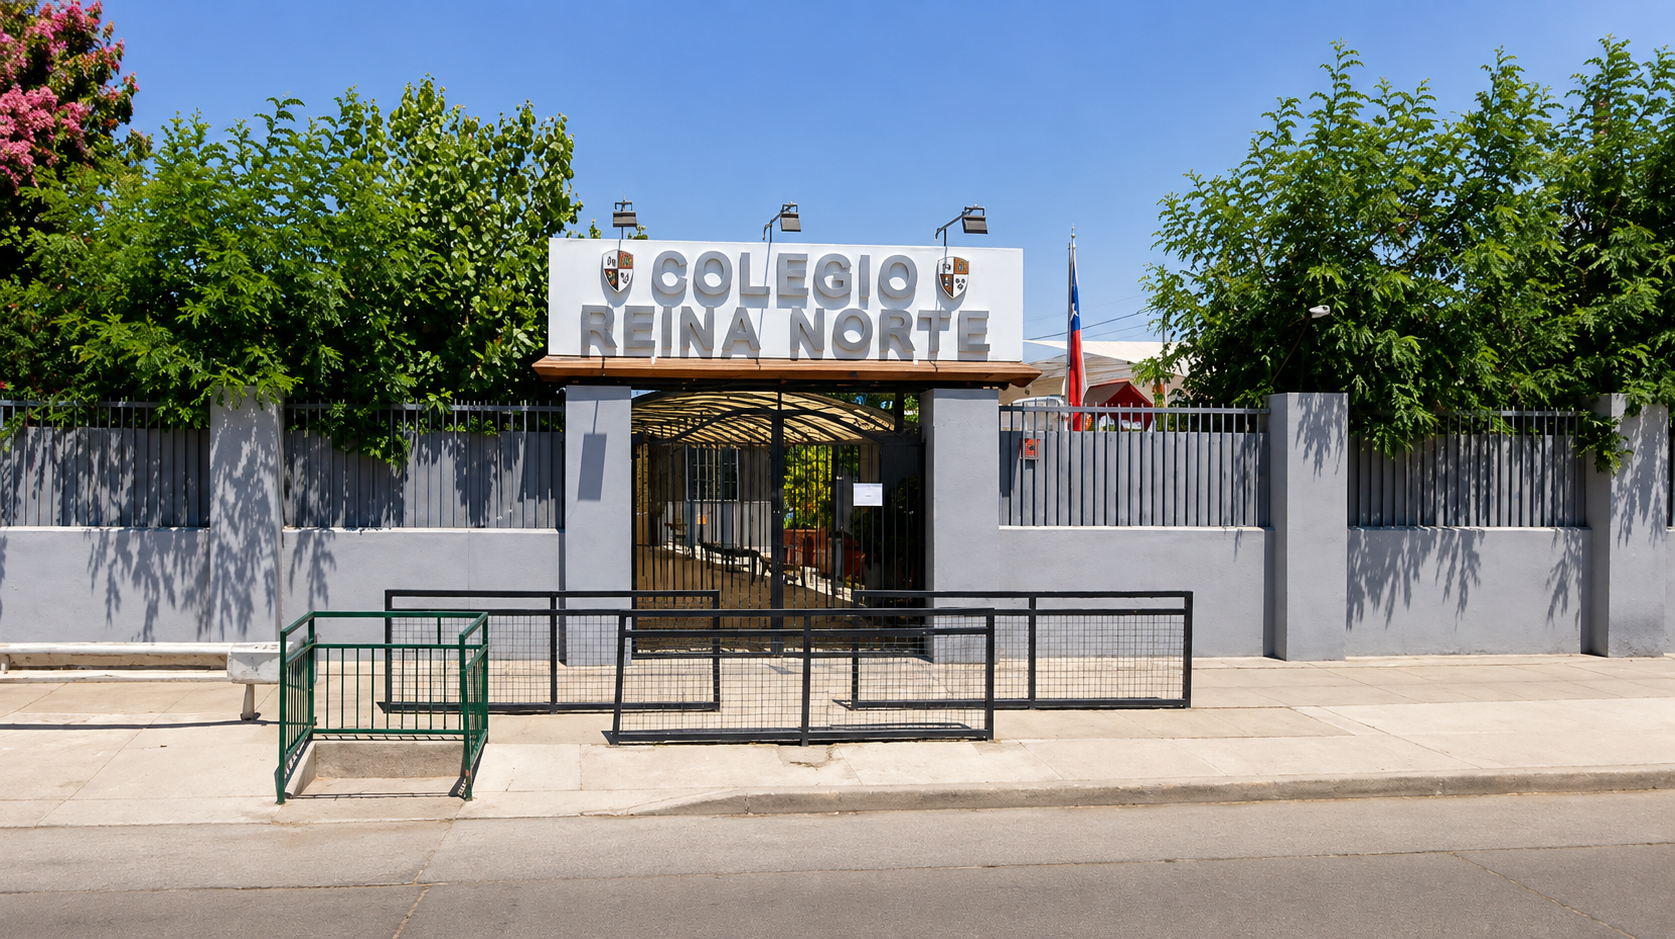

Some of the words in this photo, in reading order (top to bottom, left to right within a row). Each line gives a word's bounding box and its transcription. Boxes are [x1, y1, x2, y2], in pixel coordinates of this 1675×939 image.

[652, 250, 918, 298] COLEGIO
[581, 305, 761, 352] REINA
[790, 307, 991, 352] NORTE
